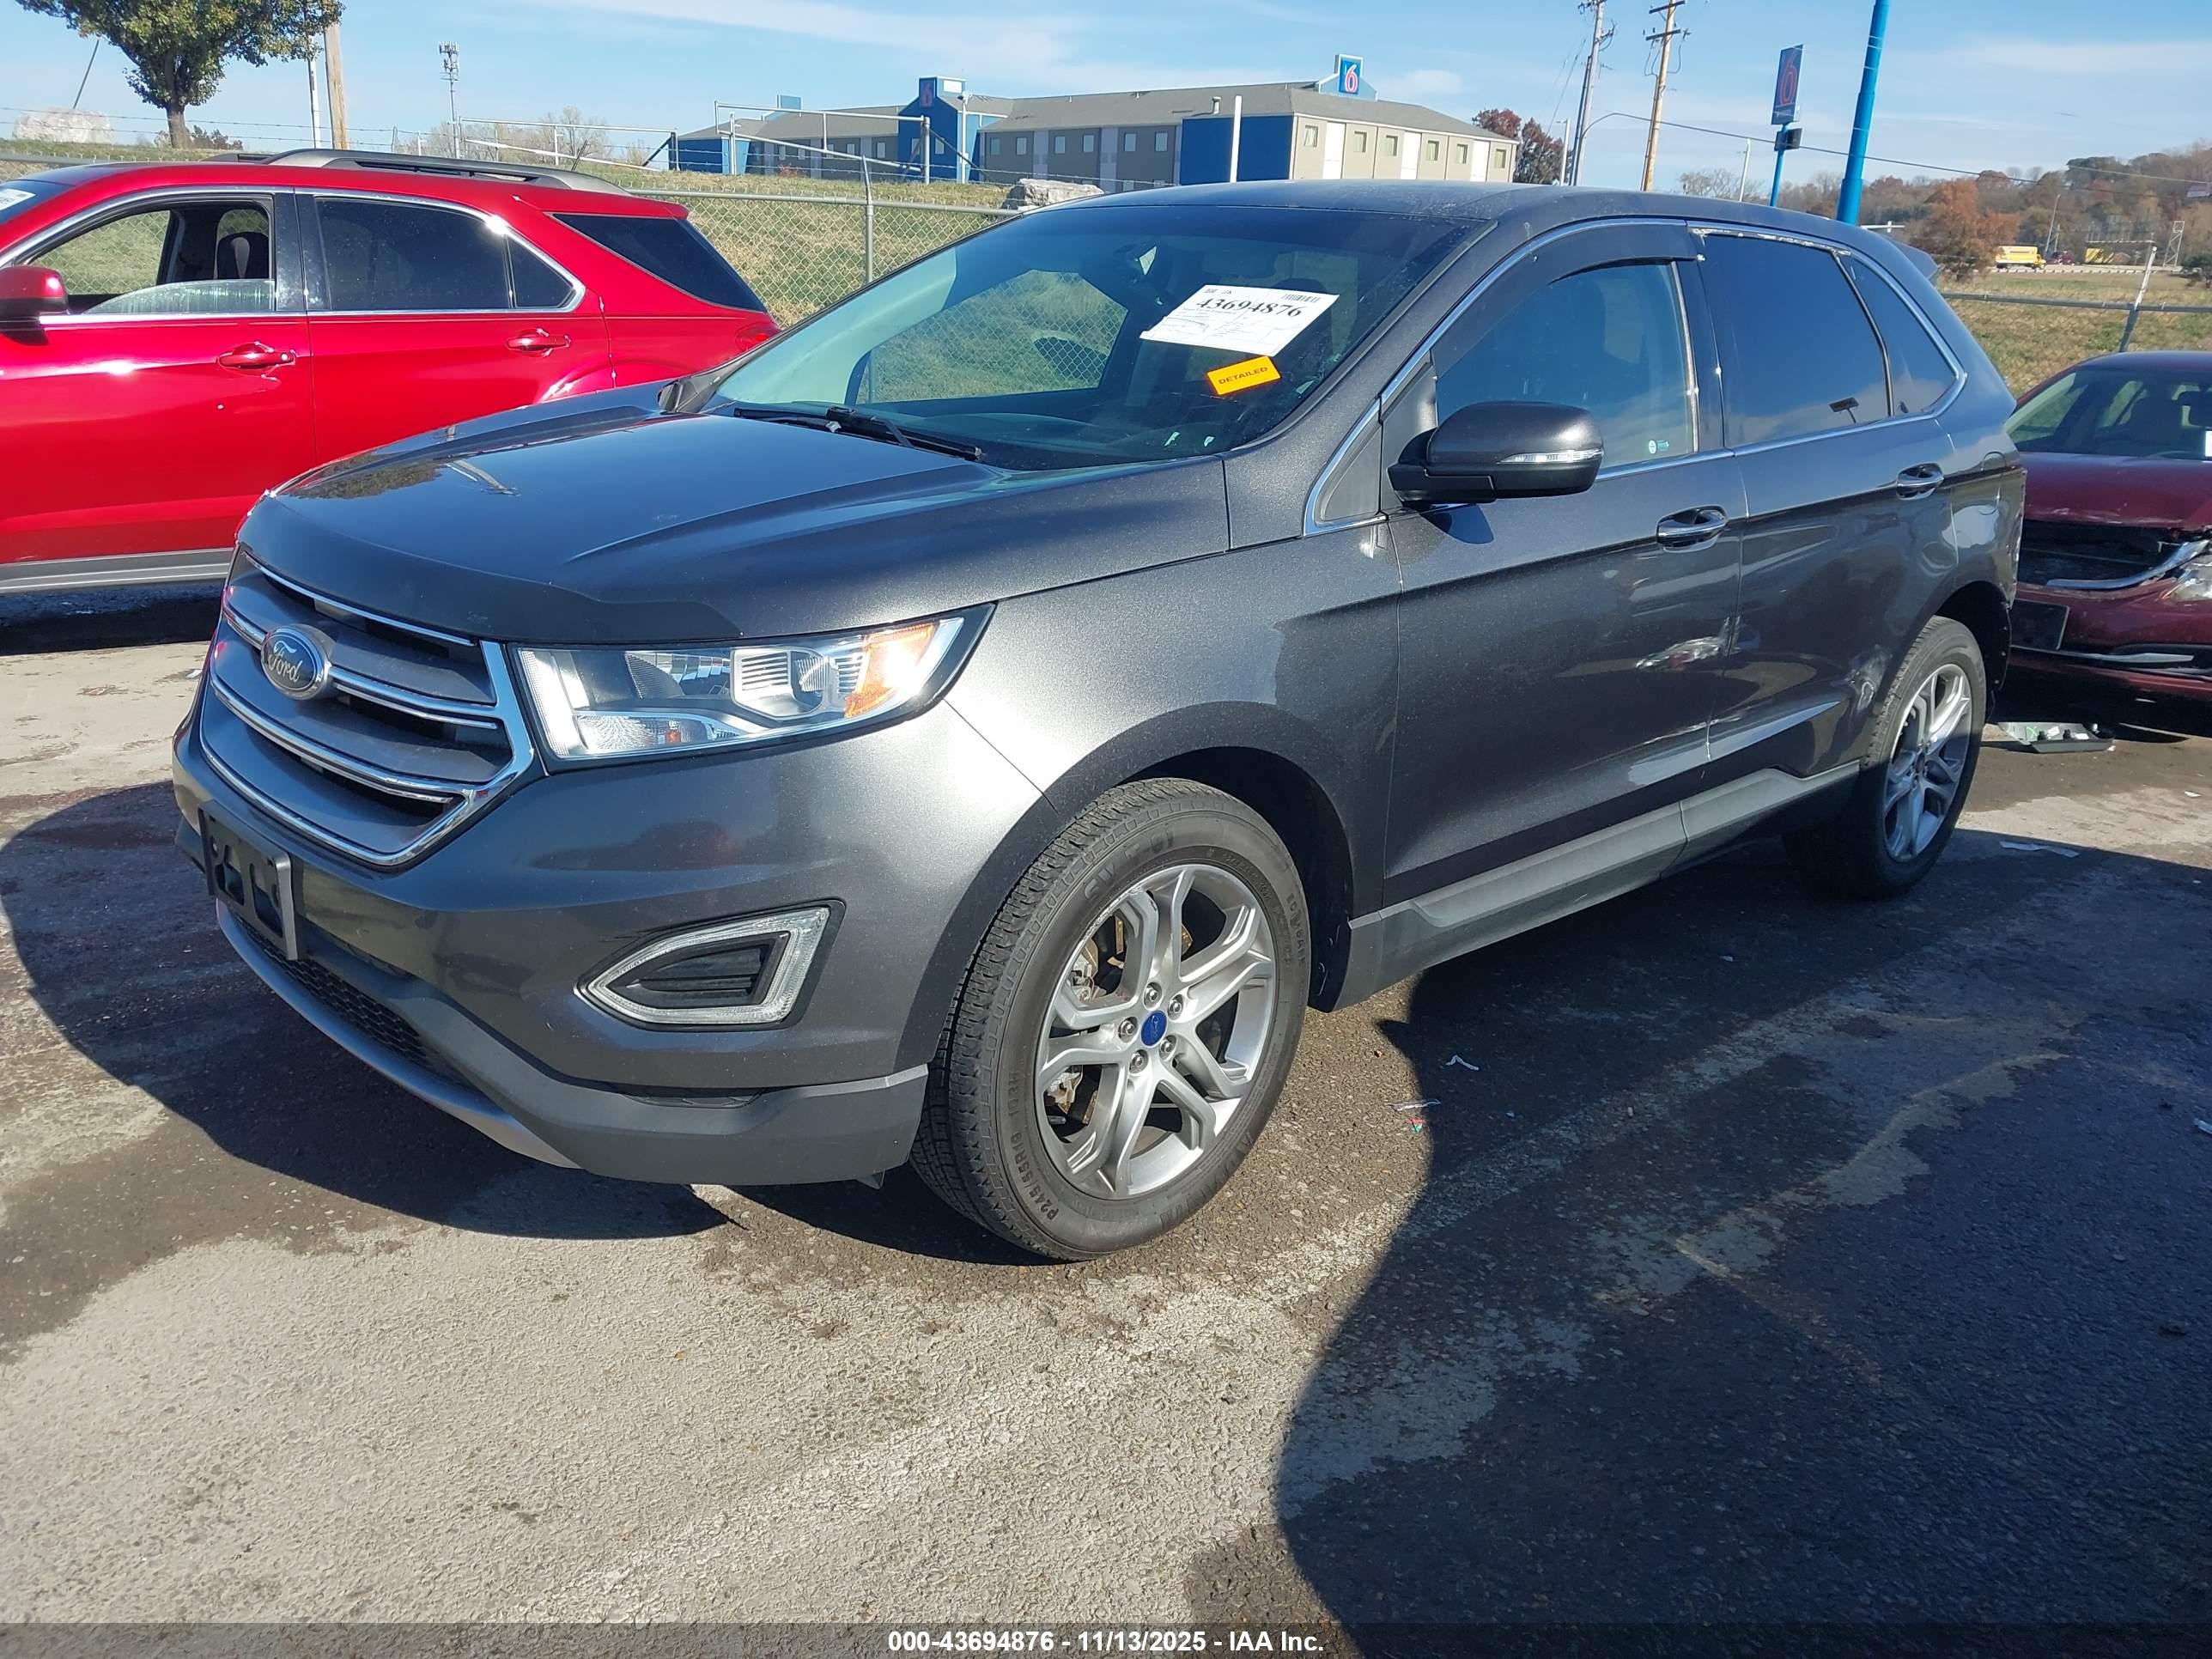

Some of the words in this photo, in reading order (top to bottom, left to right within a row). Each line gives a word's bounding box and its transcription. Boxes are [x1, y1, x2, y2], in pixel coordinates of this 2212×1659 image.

[1345, 64, 1358, 94] 6
[1778, 47, 1798, 106] 6
[1196, 297, 1307, 318] 43694876
[1218, 366, 1268, 385] DETAILED
[268, 640, 303, 683] Ford
